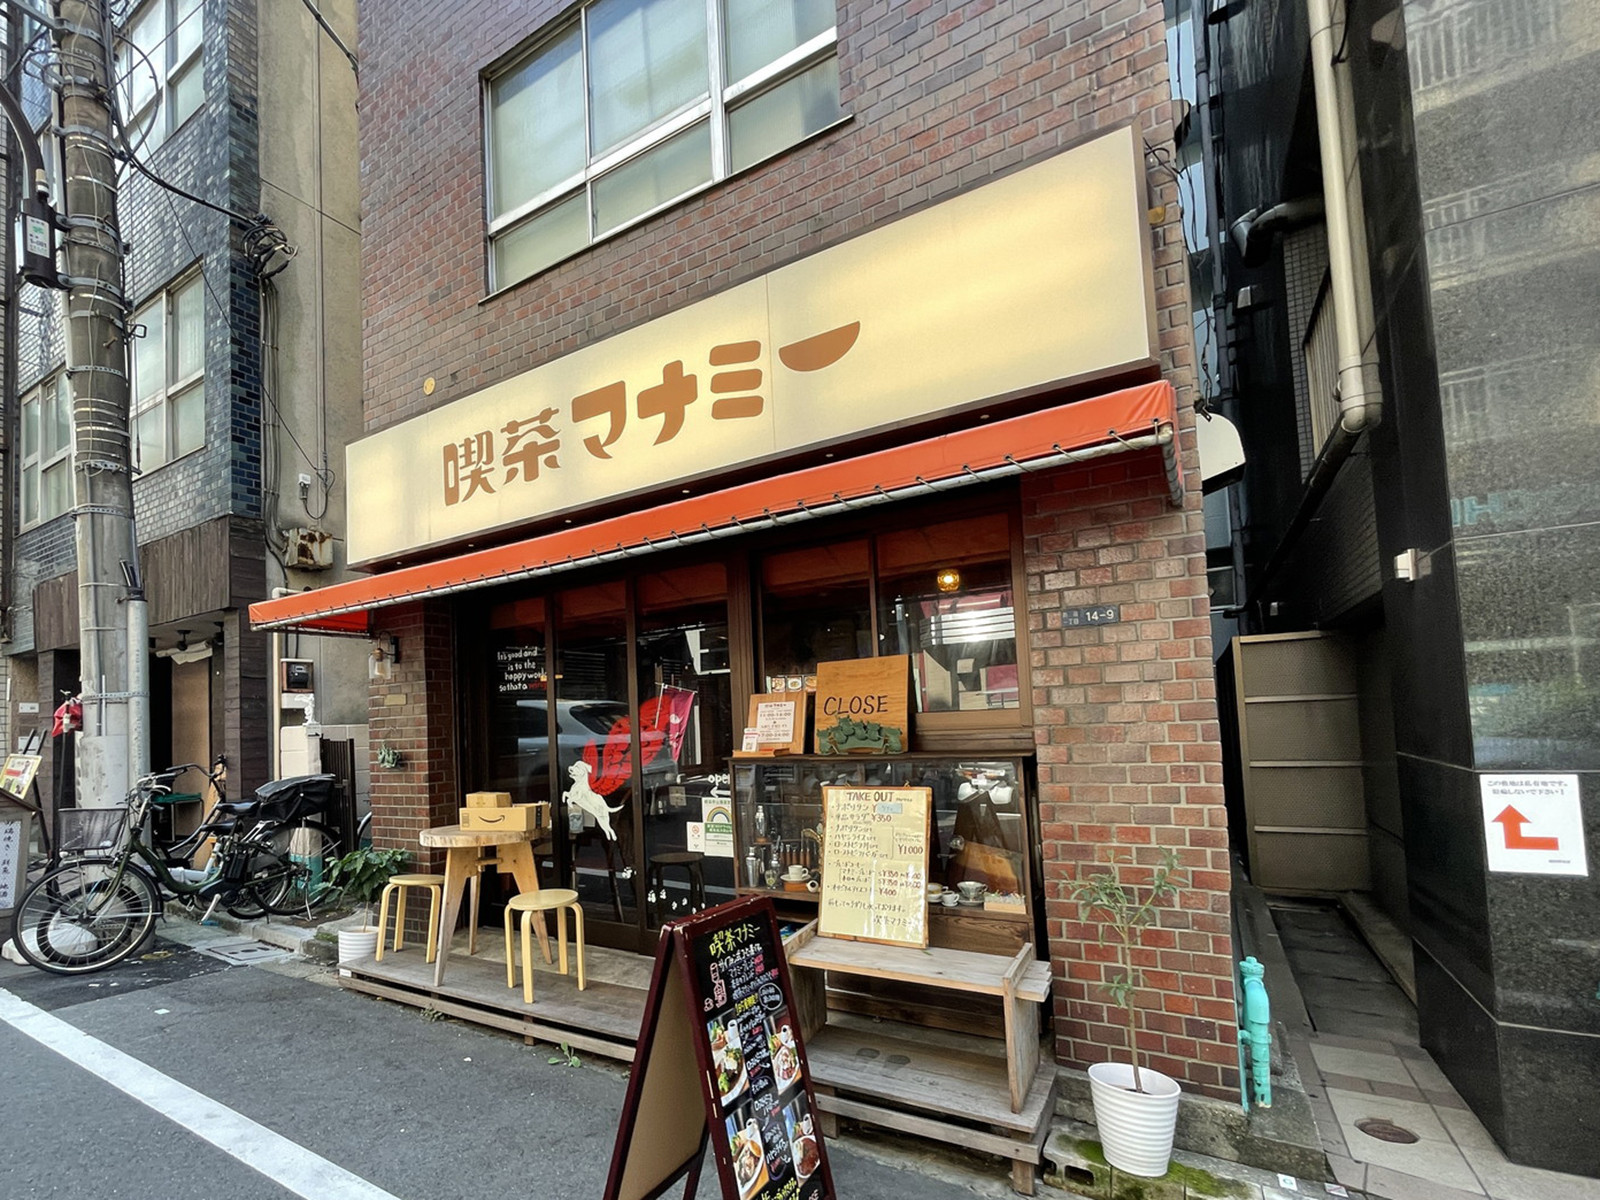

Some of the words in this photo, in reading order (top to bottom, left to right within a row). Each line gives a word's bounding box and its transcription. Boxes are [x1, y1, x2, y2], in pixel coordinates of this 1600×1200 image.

[1085, 609, 1114, 621] 14-9
[523, 646, 538, 657] and
[515, 662, 522, 670] to
[524, 659, 536, 669] the
[505, 671, 526, 682] happy
[823, 695, 888, 716] CLOSE
[846, 792, 871, 801] TAKE
[874, 791, 894, 801] OUT
[836, 803, 869, 811] ナポリタン
[871, 814, 892, 822] ¥350
[898, 844, 923, 855] ¥1000
[879, 887, 897, 896] ¥400
[709, 923, 760, 958] 喫茶マナミー
